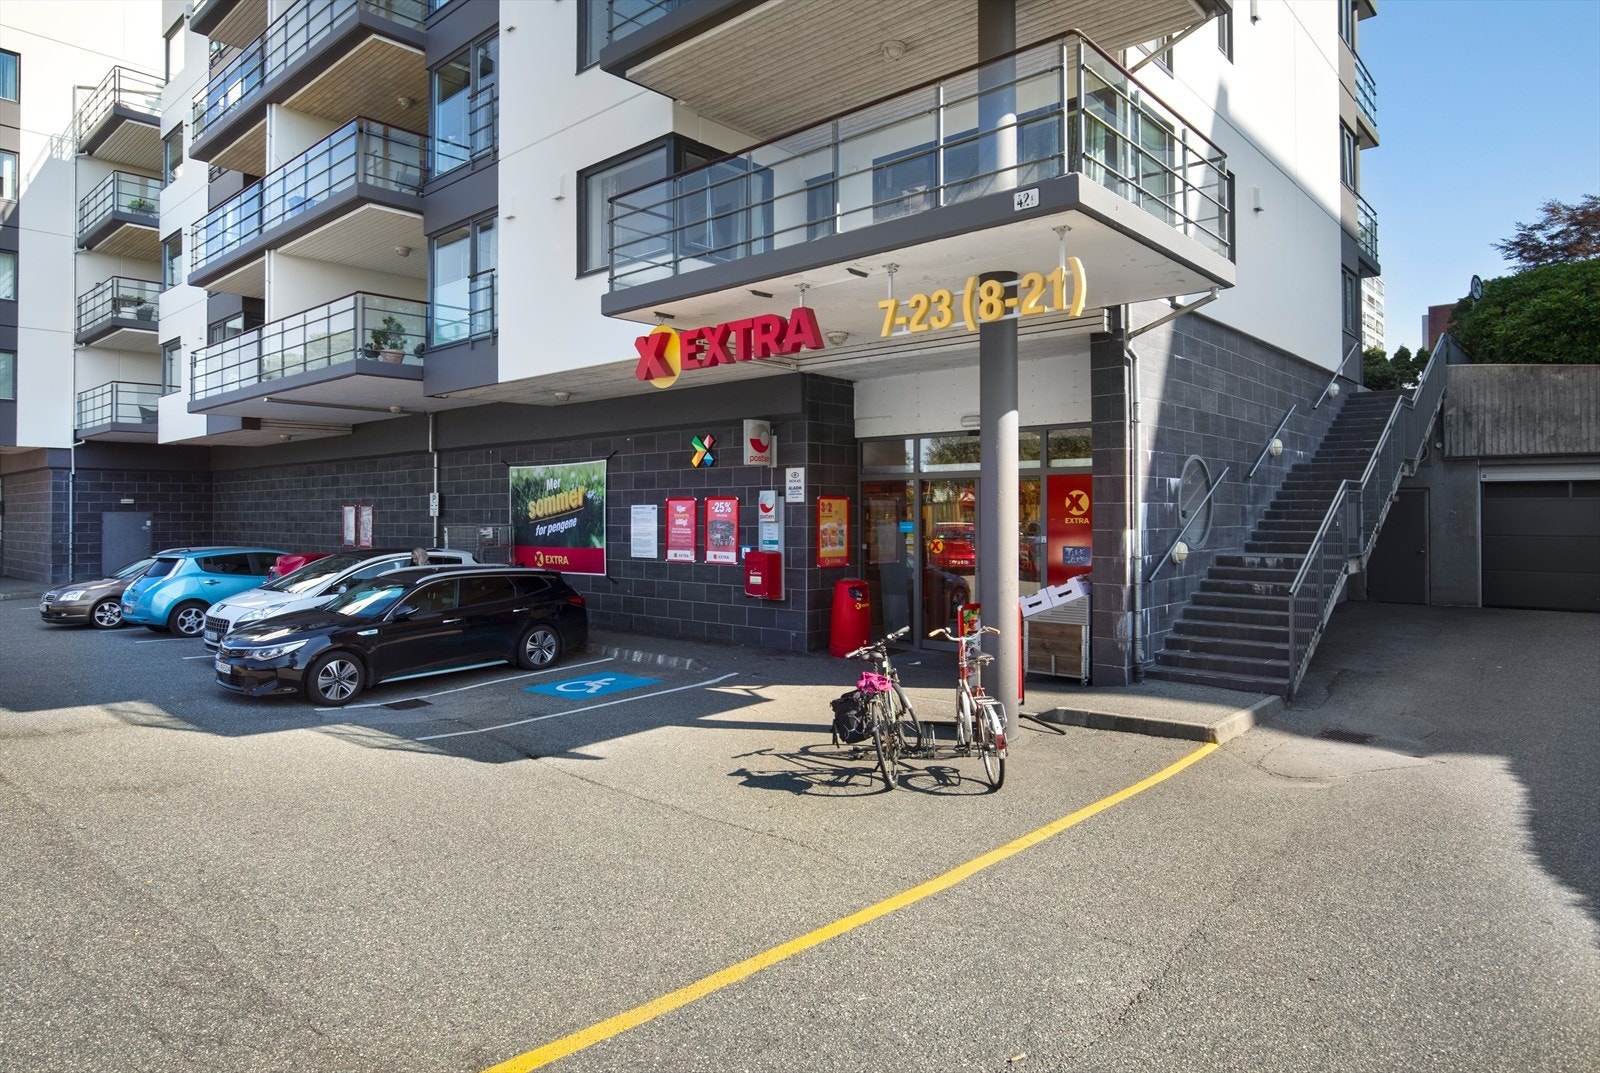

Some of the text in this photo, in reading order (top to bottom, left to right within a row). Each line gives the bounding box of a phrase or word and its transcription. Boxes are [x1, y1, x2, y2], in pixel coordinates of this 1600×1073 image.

[878, 256, 1087, 338] 7-23 (8-21)
[679, 306, 825, 371] EXTRA
[546, 478, 562, 491] Mer
[528, 485, 587, 519] sommer
[712, 502, 732, 513] -25%
[535, 517, 577, 536] for pengene
[545, 555, 569, 565] EXTRA
